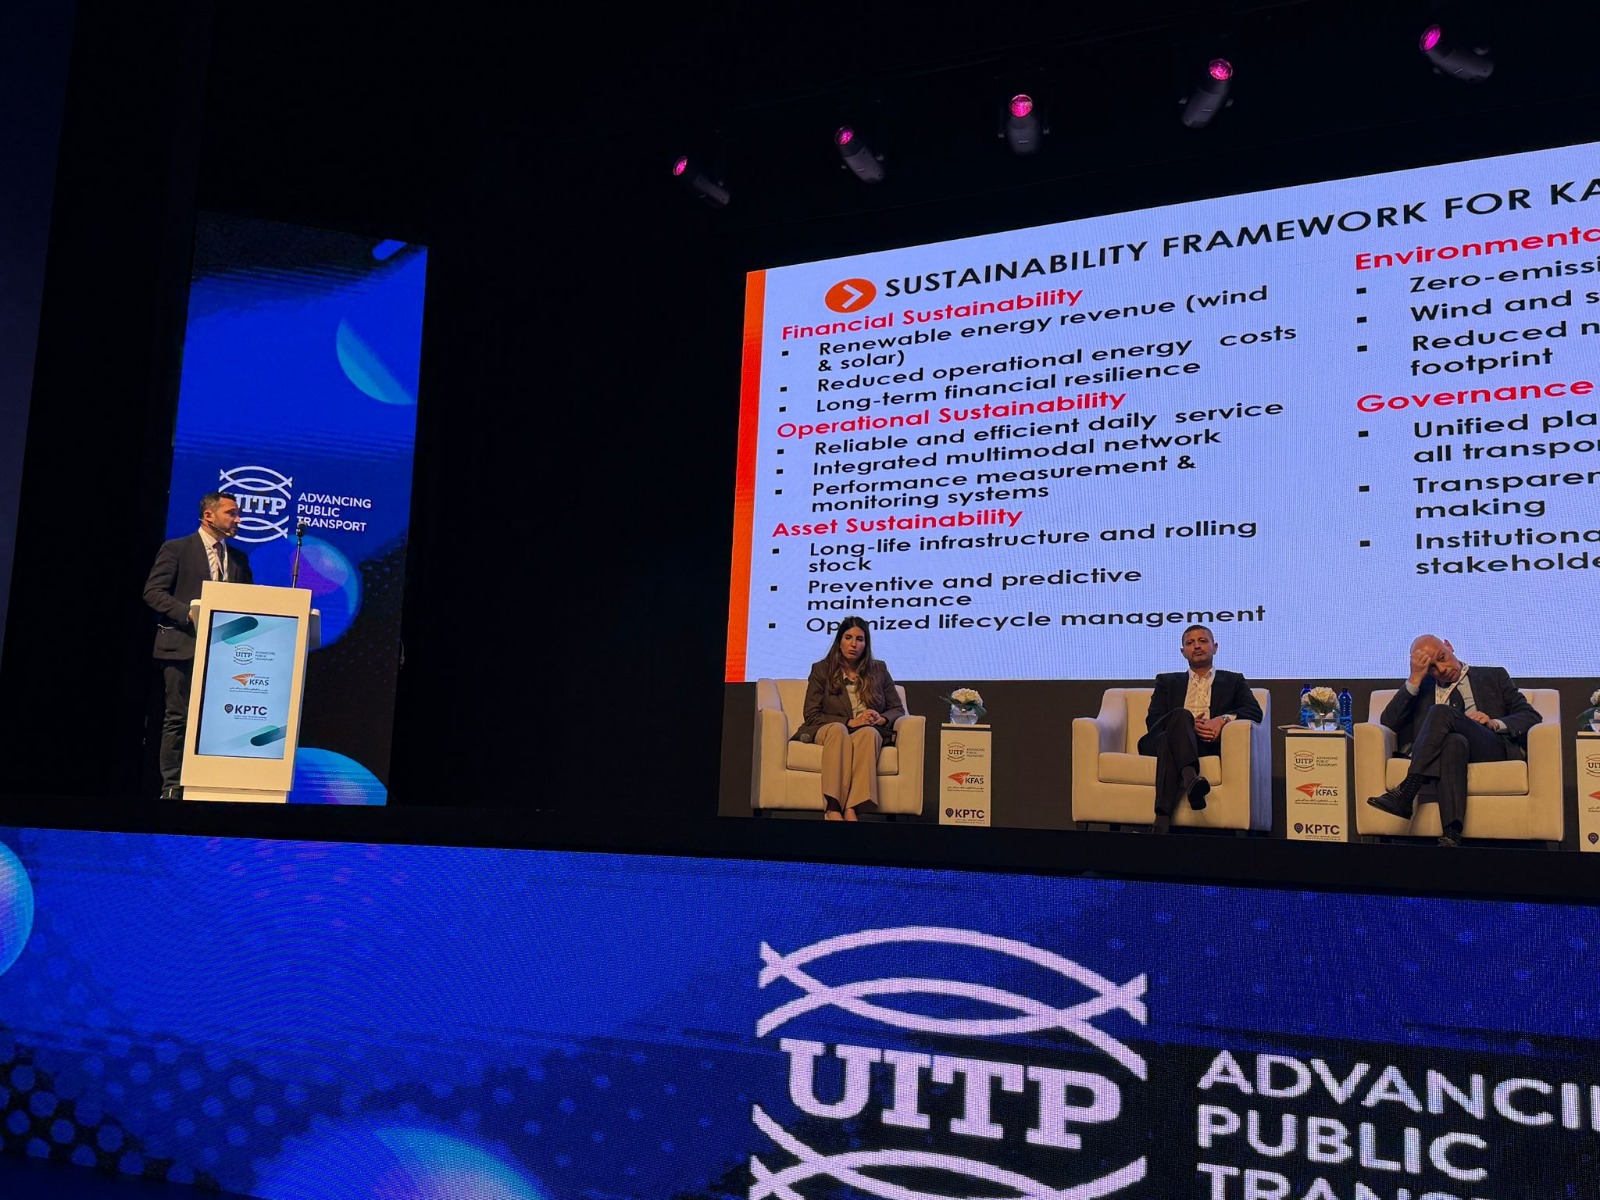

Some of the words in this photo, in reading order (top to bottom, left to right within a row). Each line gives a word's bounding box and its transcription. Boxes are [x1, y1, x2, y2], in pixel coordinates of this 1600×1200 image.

[885, 241, 1148, 297] SUSTAINABILITY
[1163, 202, 1427, 257] FRAMEWORK
[1445, 189, 1532, 219] FOR
[782, 312, 893, 340] Financial
[903, 289, 1083, 325] Sustainability
[820, 328, 952, 356] Renewable
[960, 317, 1052, 338] energy
[1060, 302, 1176, 326] revenue
[1186, 285, 1267, 313] (wind
[1410, 298, 1492, 322] Wind
[1505, 290, 1572, 312] and
[1413, 320, 1567, 352] Reduced
[818, 367, 924, 392] Reduced
[932, 348, 1082, 382] operational
[1091, 340, 1192, 361] energy
[1220, 325, 1296, 346] costs
[818, 359, 832, 372] &
[840, 350, 904, 370] solar)
[1410, 348, 1553, 376] footprint
[817, 391, 937, 412] Long-term
[944, 374, 1056, 400] financial
[1065, 362, 1200, 387] resilience
[1357, 381, 1594, 412] Governance
[777, 410, 929, 439] Operational
[939, 392, 1126, 423] Sustainability
[815, 435, 908, 455] Reliable
[916, 428, 964, 446] and
[974, 418, 1080, 441] efficient
[1088, 412, 1157, 431] daily
[1175, 402, 1284, 423] service
[1414, 413, 1528, 438] Unified
[1542, 410, 1597, 434] pla
[814, 452, 937, 476] Integrated
[946, 438, 1094, 465] multimodal
[1104, 428, 1220, 452] network
[1414, 444, 1452, 463] all
[813, 476, 967, 496] Performance
[977, 455, 1168, 484] measurement
[1177, 455, 1196, 470] &
[297, 504, 341, 518] PUBLIC
[298, 492, 372, 509] ADVANCING
[812, 493, 938, 512] monitoring
[948, 486, 1049, 506] systems
[1416, 498, 1545, 519] making
[772, 519, 838, 537] Asset
[846, 508, 1023, 533] Sustainability
[810, 538, 911, 557] Long-life
[920, 530, 1090, 550] infrastructure
[1100, 523, 1155, 541] and
[1165, 520, 1256, 538] rolling
[809, 556, 872, 573] stock
[809, 576, 934, 594] Preventive
[942, 572, 992, 588] and
[1002, 568, 1142, 590] predictive
[808, 594, 972, 610] maintenance
[939, 611, 1051, 631] lifecycle
[1061, 605, 1266, 628] management
[234, 704, 268, 716] KPTC
[1315, 789, 1338, 797] KFAS
[955, 809, 985, 819] KPTC
[1305, 824, 1340, 835] KPTC
[780, 1038, 1122, 1150] UITP
[1196, 1050, 1600, 1132] ADVANCI
[1196, 1104, 1488, 1182] PUBLIC
